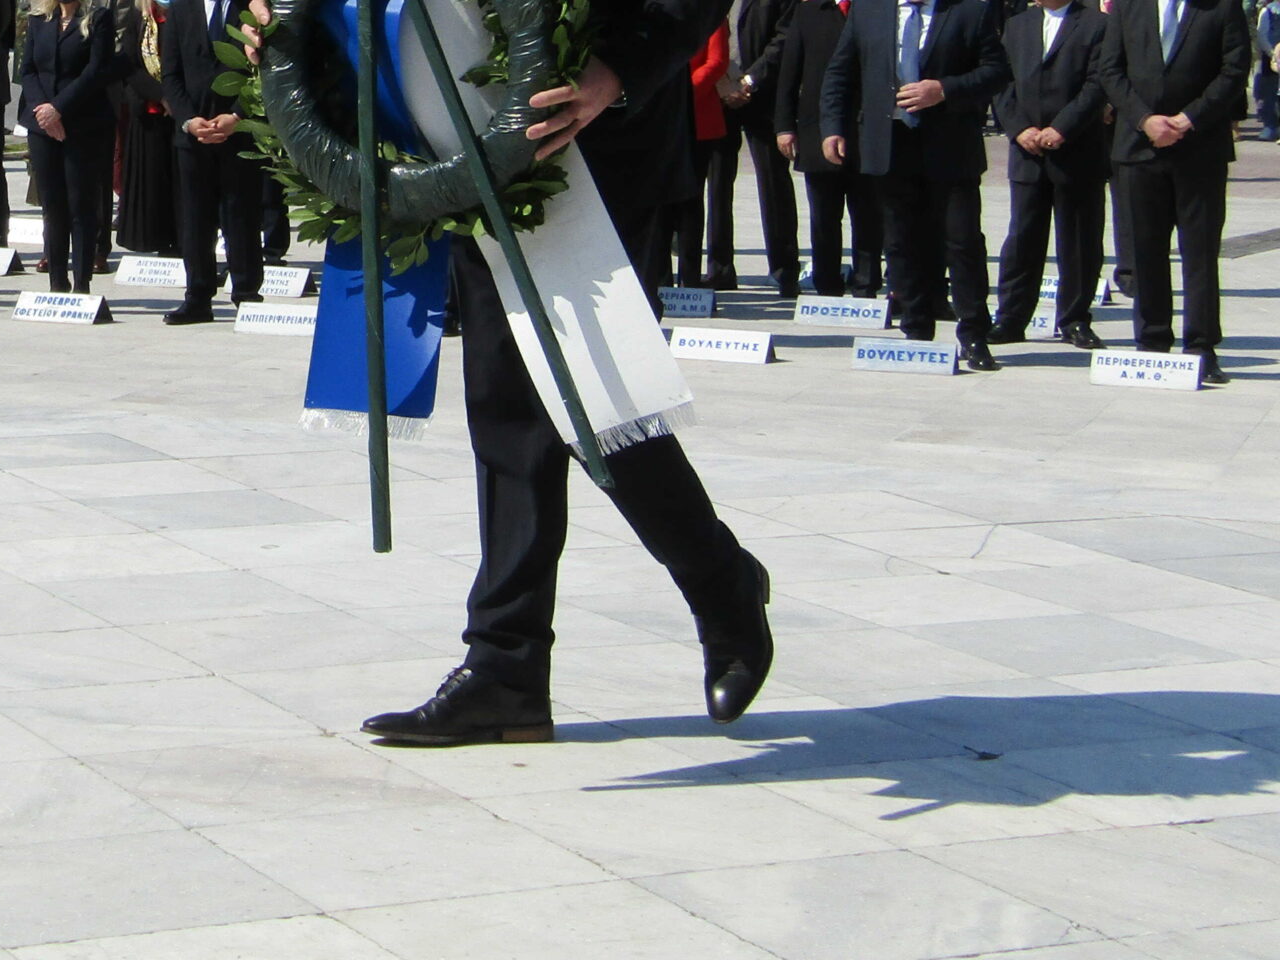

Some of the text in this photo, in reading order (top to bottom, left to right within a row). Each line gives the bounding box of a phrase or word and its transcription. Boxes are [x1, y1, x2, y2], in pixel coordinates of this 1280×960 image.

[33, 295, 84, 307] ΠΡΟΕΔΡΟΣ
[658, 291, 703, 302] ΦΕΡΙΑΚΟΙ
[60, 310, 96, 321] ΘΡΑΚΗΣ
[800, 305, 882, 319] ΠΡΟΞΕΝΟΣ
[240, 313, 317, 326] ΑΝΤΙΠΕΡΙΦΕΡΕΙΑΡΧΗ
[678, 338, 760, 352] ΒΟΥΛΕΥΤΗΣ
[856, 348, 949, 364] ΒΟΥΛΕΥΤΕΣ
[1096, 356, 1195, 371] ΠΕΡΙΦΕΡΕΙΑΡΧΗΣ
